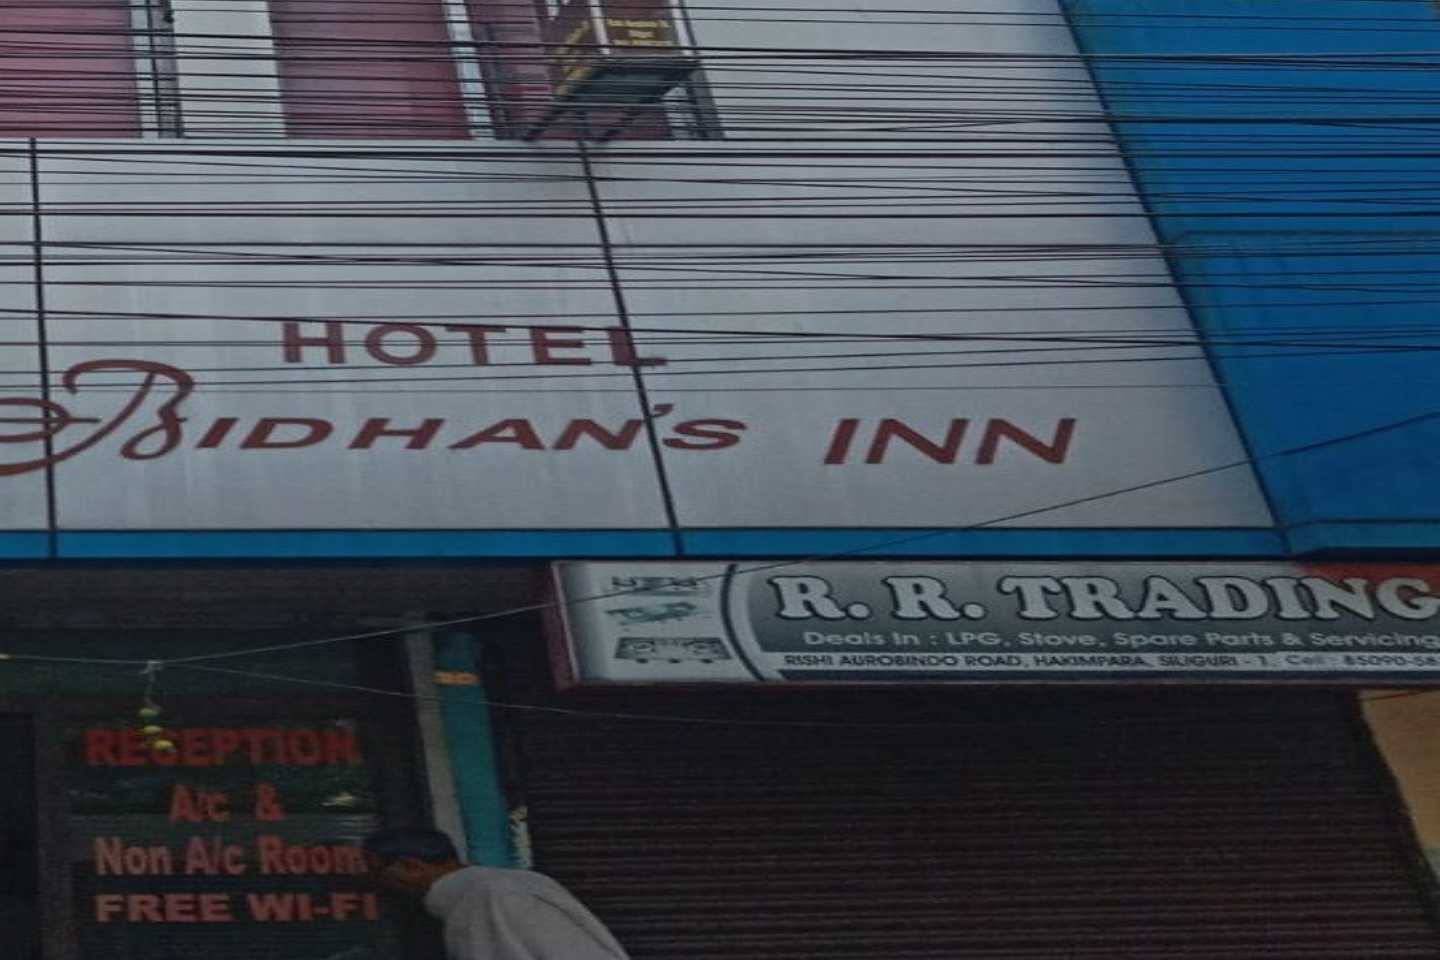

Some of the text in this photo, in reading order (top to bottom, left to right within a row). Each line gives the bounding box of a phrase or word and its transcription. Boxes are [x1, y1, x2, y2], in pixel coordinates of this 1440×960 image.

[281, 320, 668, 367] HOTEL
[822, 416, 1078, 466] INN
[768, 575, 1440, 622] R. R. TRADING
[804, 631, 884, 647] Deals
[1113, 631, 1198, 649] Spare
[1205, 631, 1274, 647] Parts
[1281, 632, 1305, 646] &
[1310, 631, 1440, 650] Servicing
[83, 727, 362, 767] RECEPTION
[255, 782, 287, 823] &
[92, 836, 173, 876] Non
[94, 892, 383, 924] FREE WI-FI
